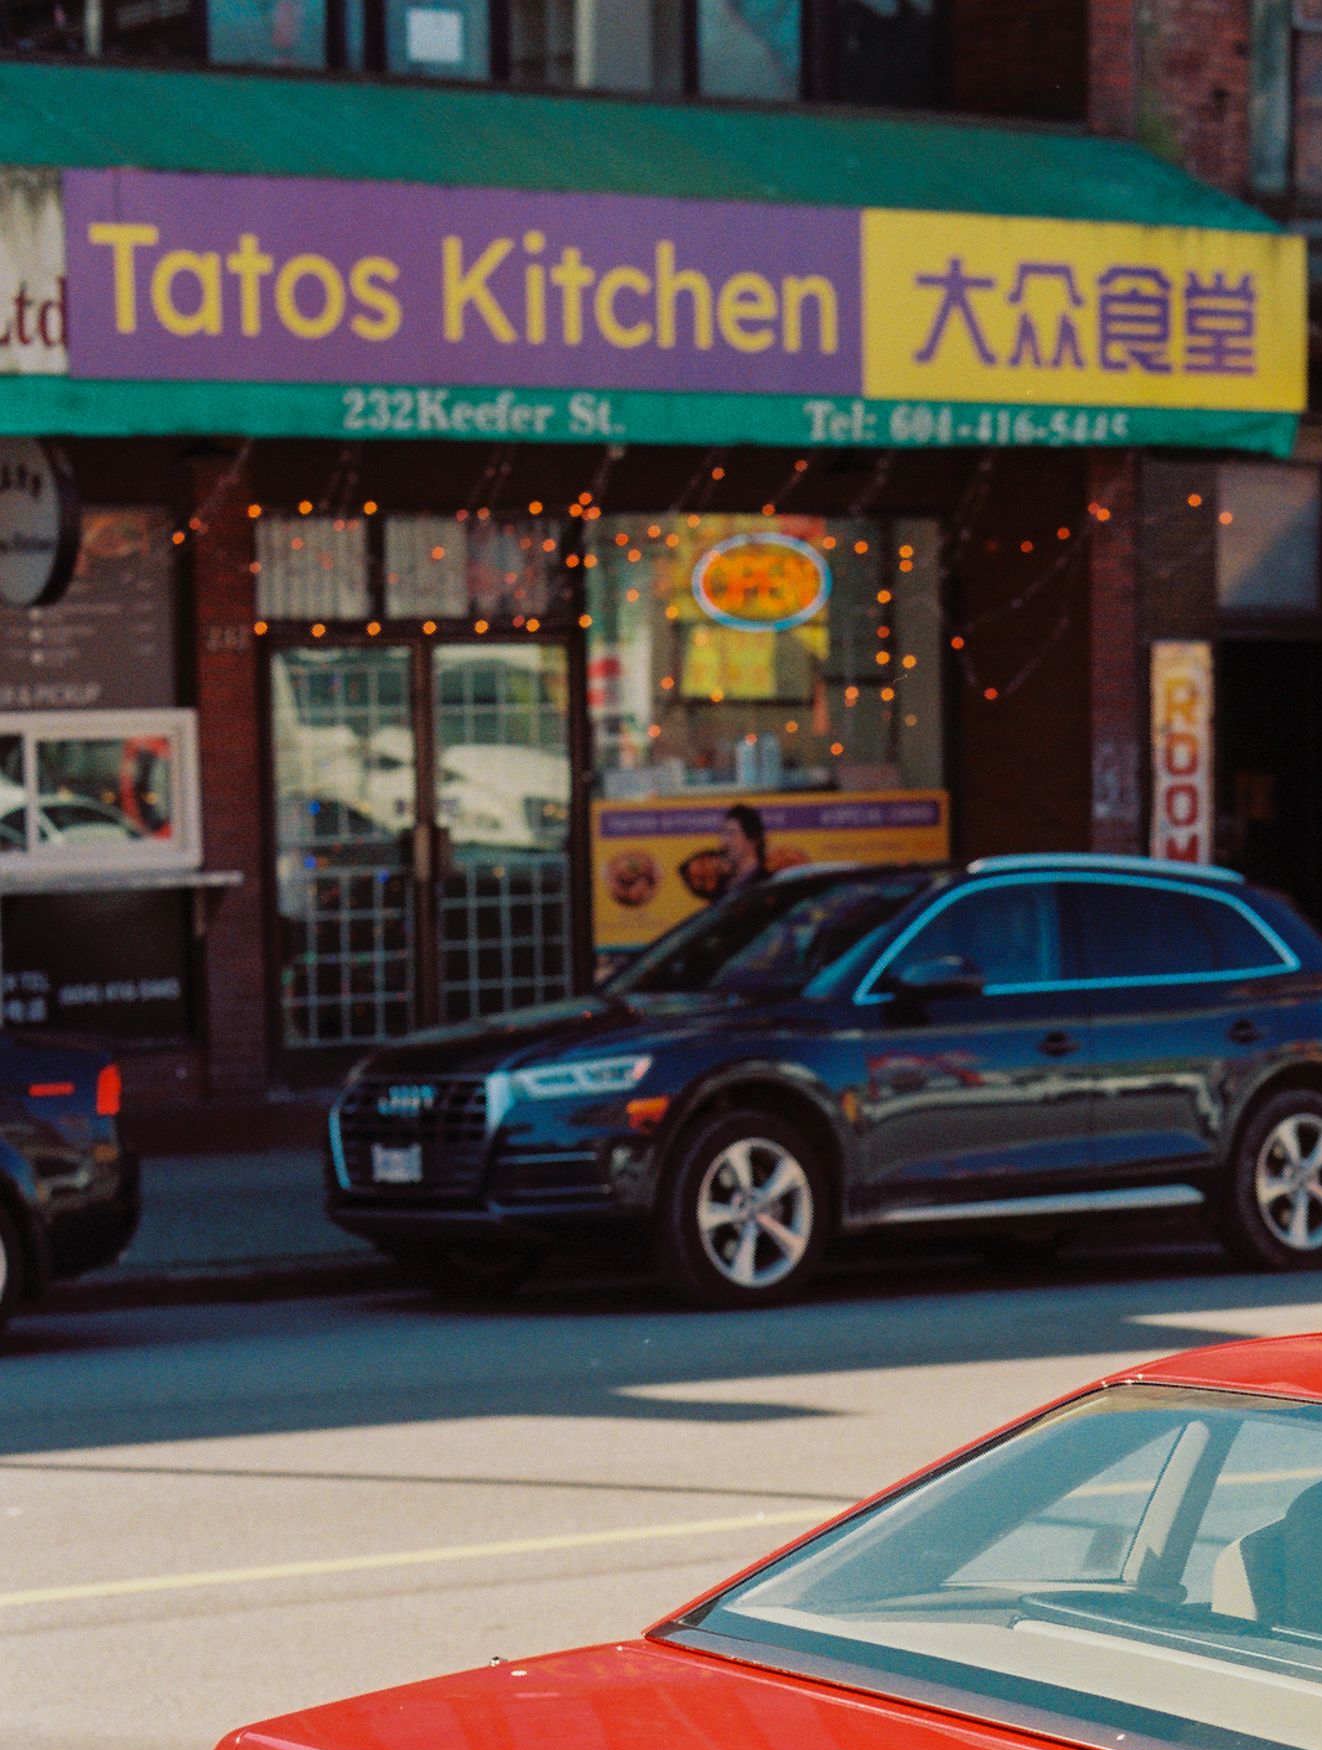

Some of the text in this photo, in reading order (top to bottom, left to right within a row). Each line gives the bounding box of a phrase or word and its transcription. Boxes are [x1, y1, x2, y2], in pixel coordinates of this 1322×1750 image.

[88, 222, 839, 355] Tatos Kitchen
[914, 257, 1257, 377] 大众食堂
[568, 392, 626, 436] St.
[803, 399, 877, 443] Tel:
